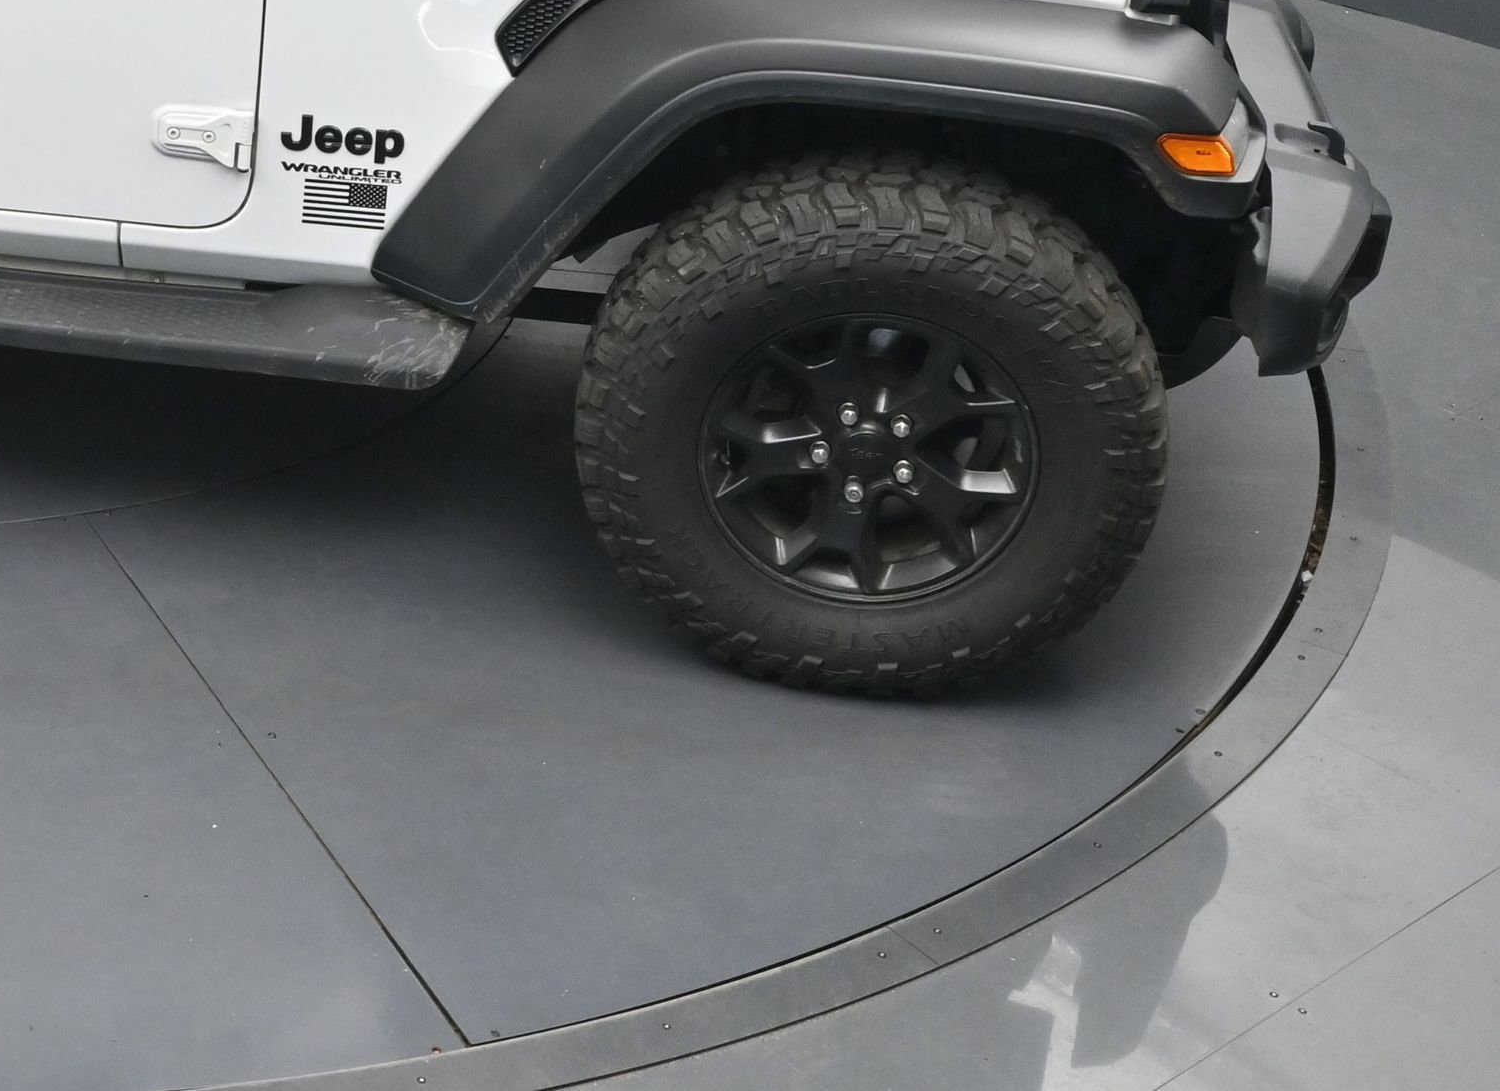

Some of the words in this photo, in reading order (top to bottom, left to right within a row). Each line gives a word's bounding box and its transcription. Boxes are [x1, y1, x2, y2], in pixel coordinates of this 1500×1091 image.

[280, 114, 405, 165] Jeep
[280, 160, 402, 181] WRANGLER
[318, 172, 403, 186] UNLIMITED
